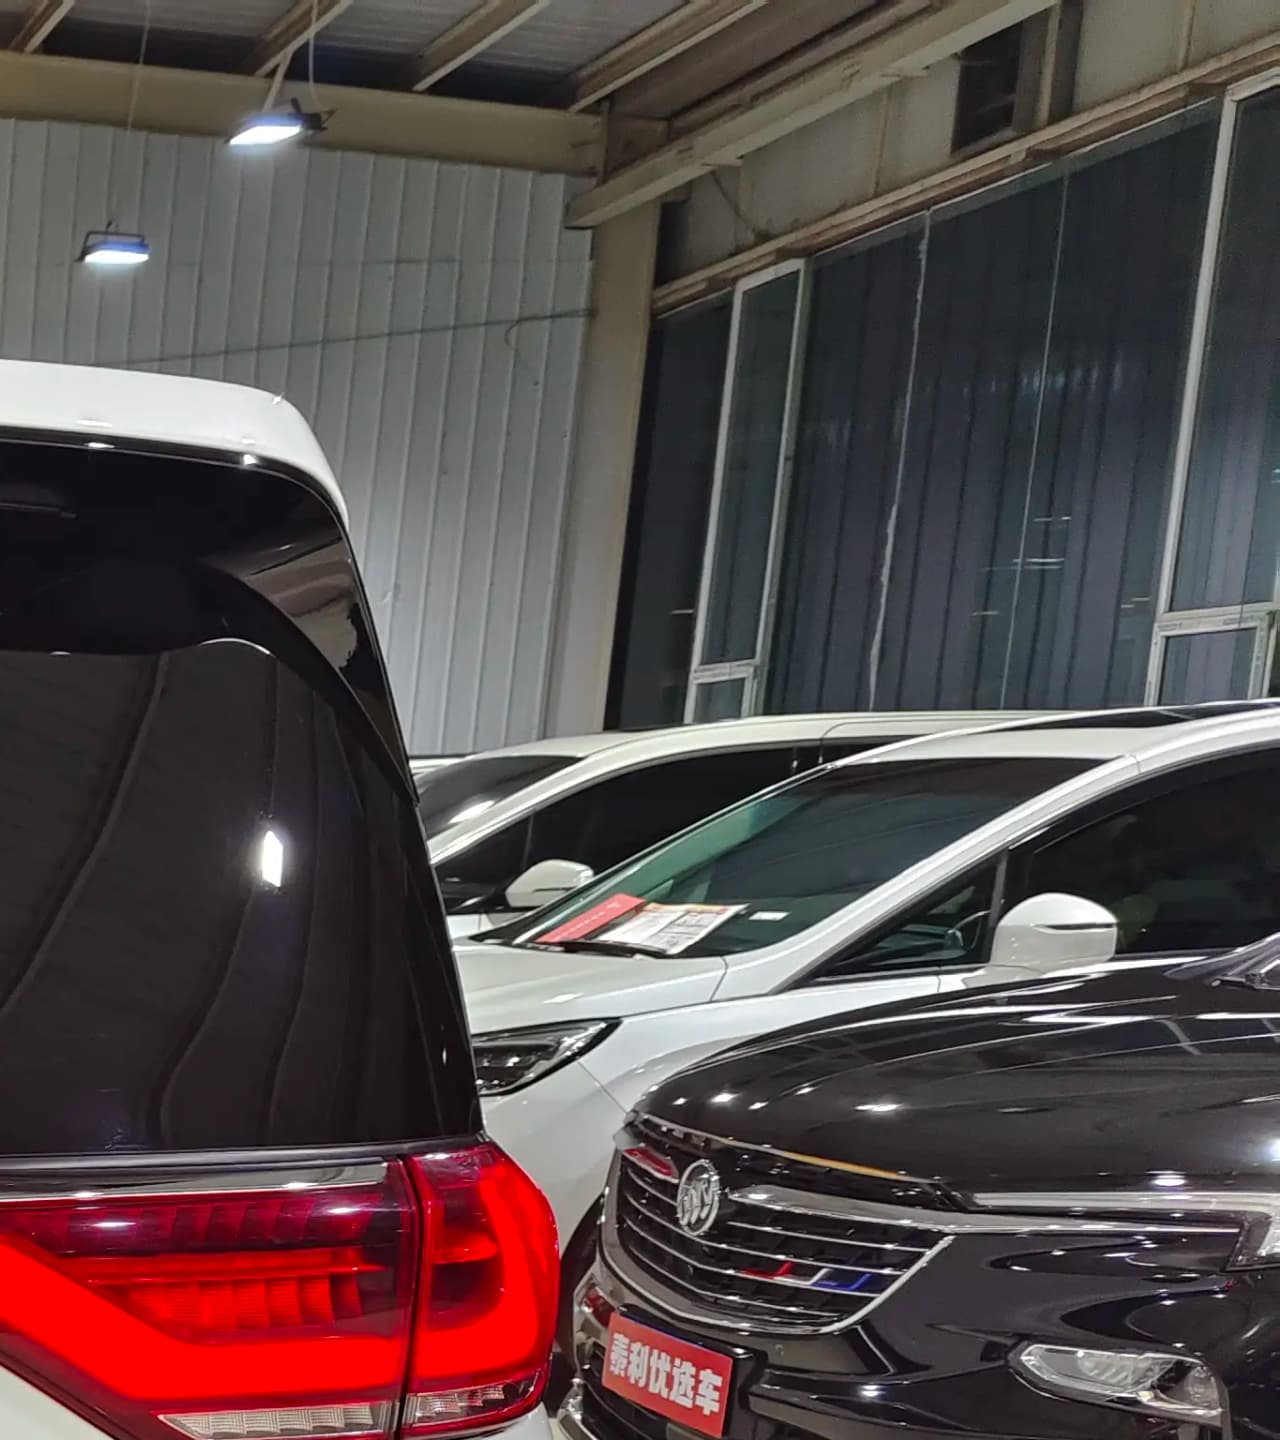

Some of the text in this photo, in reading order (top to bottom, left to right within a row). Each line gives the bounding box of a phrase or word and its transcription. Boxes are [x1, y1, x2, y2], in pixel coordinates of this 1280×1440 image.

[609, 1332, 724, 1416] 泰利优选车
